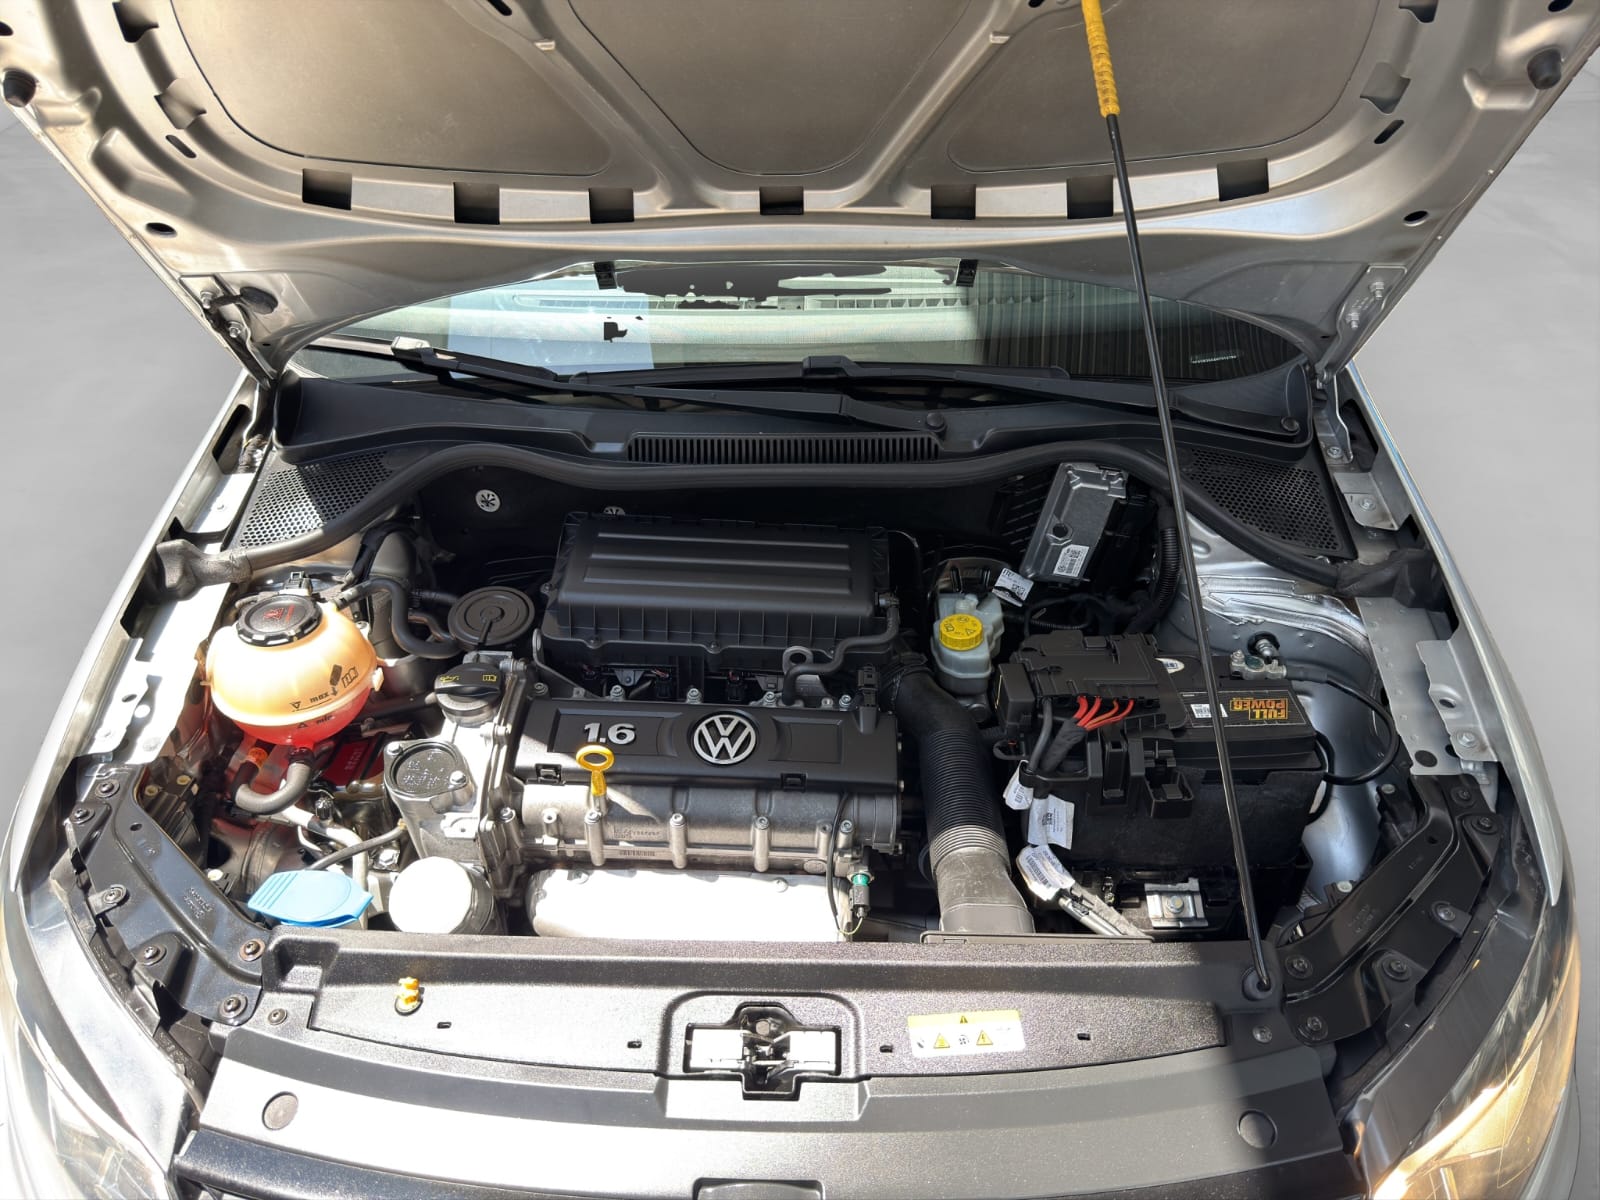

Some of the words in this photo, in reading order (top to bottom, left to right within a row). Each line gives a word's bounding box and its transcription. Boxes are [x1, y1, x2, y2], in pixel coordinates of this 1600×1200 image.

[310, 692, 330, 703] max
[1233, 698, 1286, 711] POWER
[1253, 709, 1286, 719] FULL
[583, 722, 636, 745] 1.6
